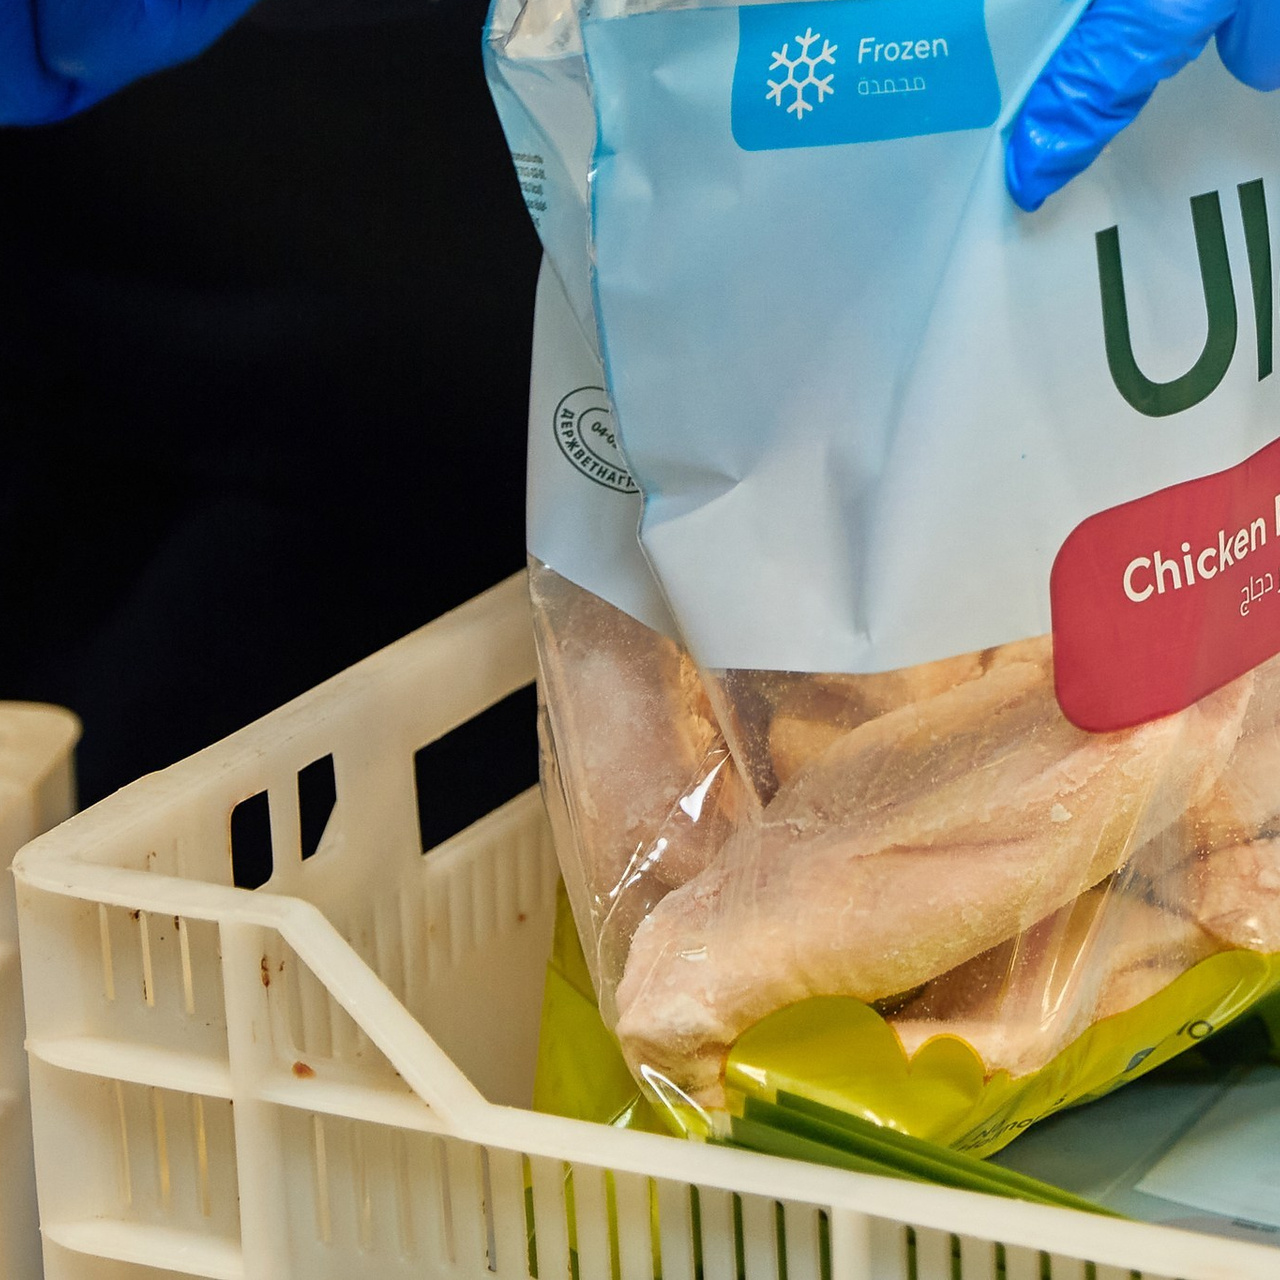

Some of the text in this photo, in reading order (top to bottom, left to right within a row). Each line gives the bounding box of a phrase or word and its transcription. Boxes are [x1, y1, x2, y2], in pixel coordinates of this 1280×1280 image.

[857, 36, 949, 64] Frozen
[1122, 516, 1267, 603] Chicken
[1239, 572, 1274, 617] دجاج
